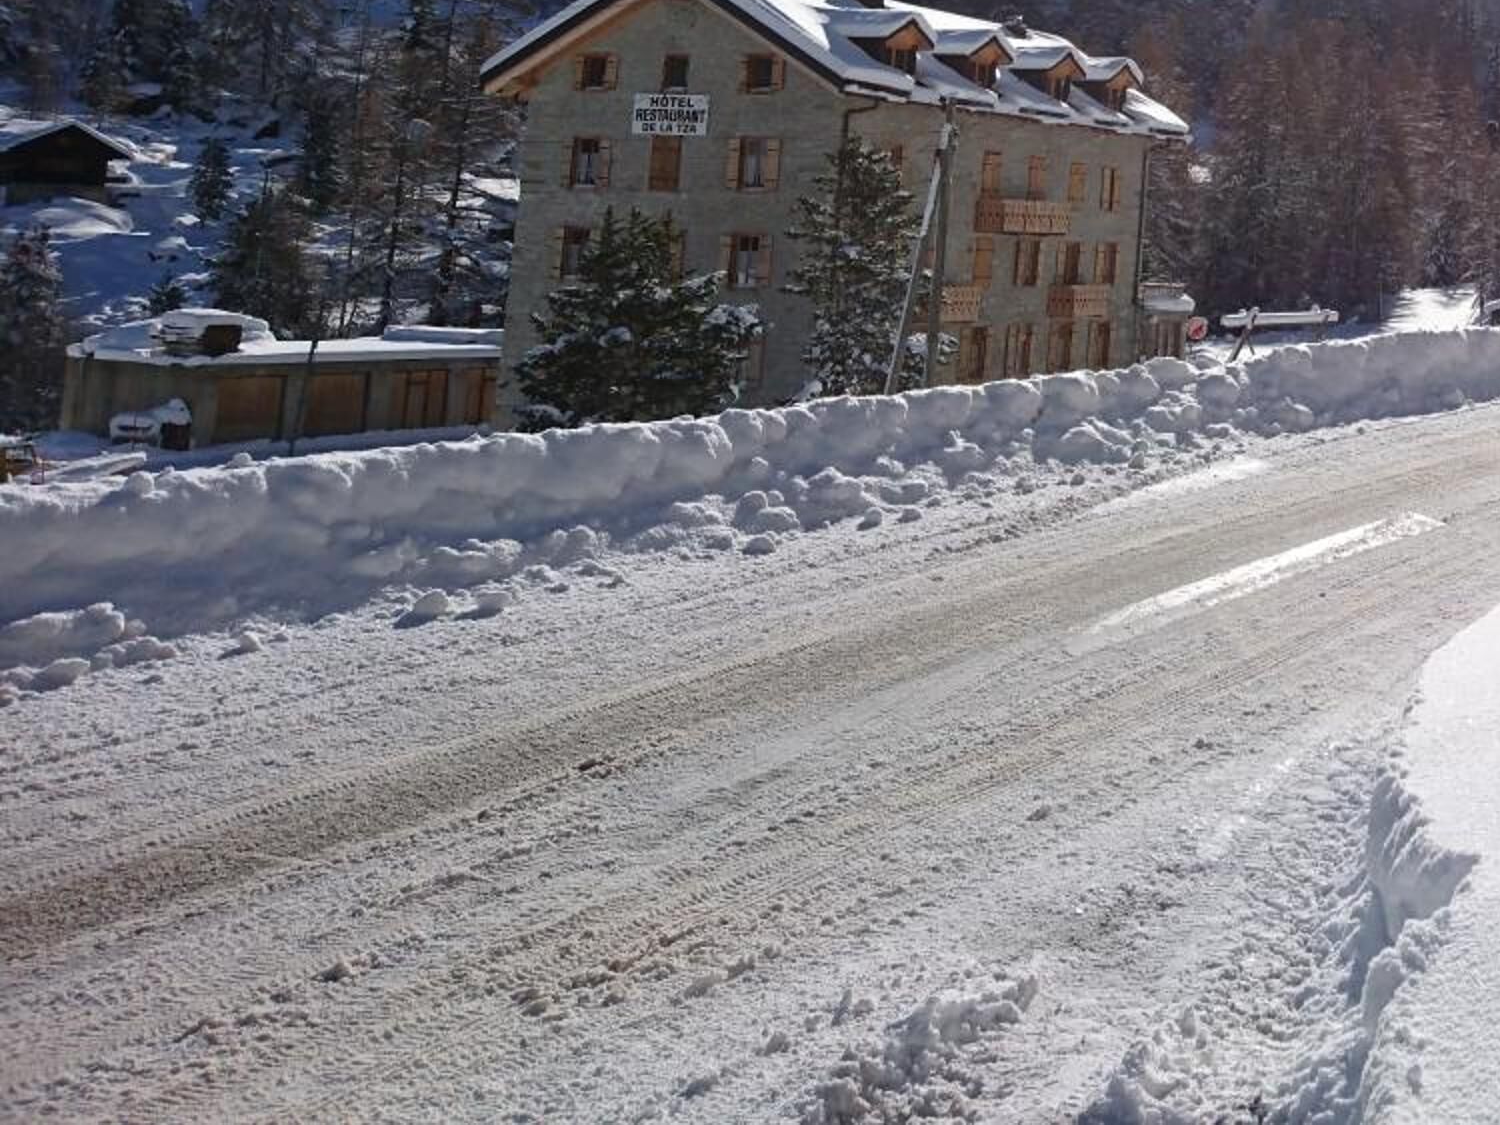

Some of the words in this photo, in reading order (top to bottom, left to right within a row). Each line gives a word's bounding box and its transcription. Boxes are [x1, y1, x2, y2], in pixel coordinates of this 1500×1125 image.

[635, 108, 706, 124] RESTAURANT
[641, 123, 656, 132] DE
[659, 123, 673, 132] LA
